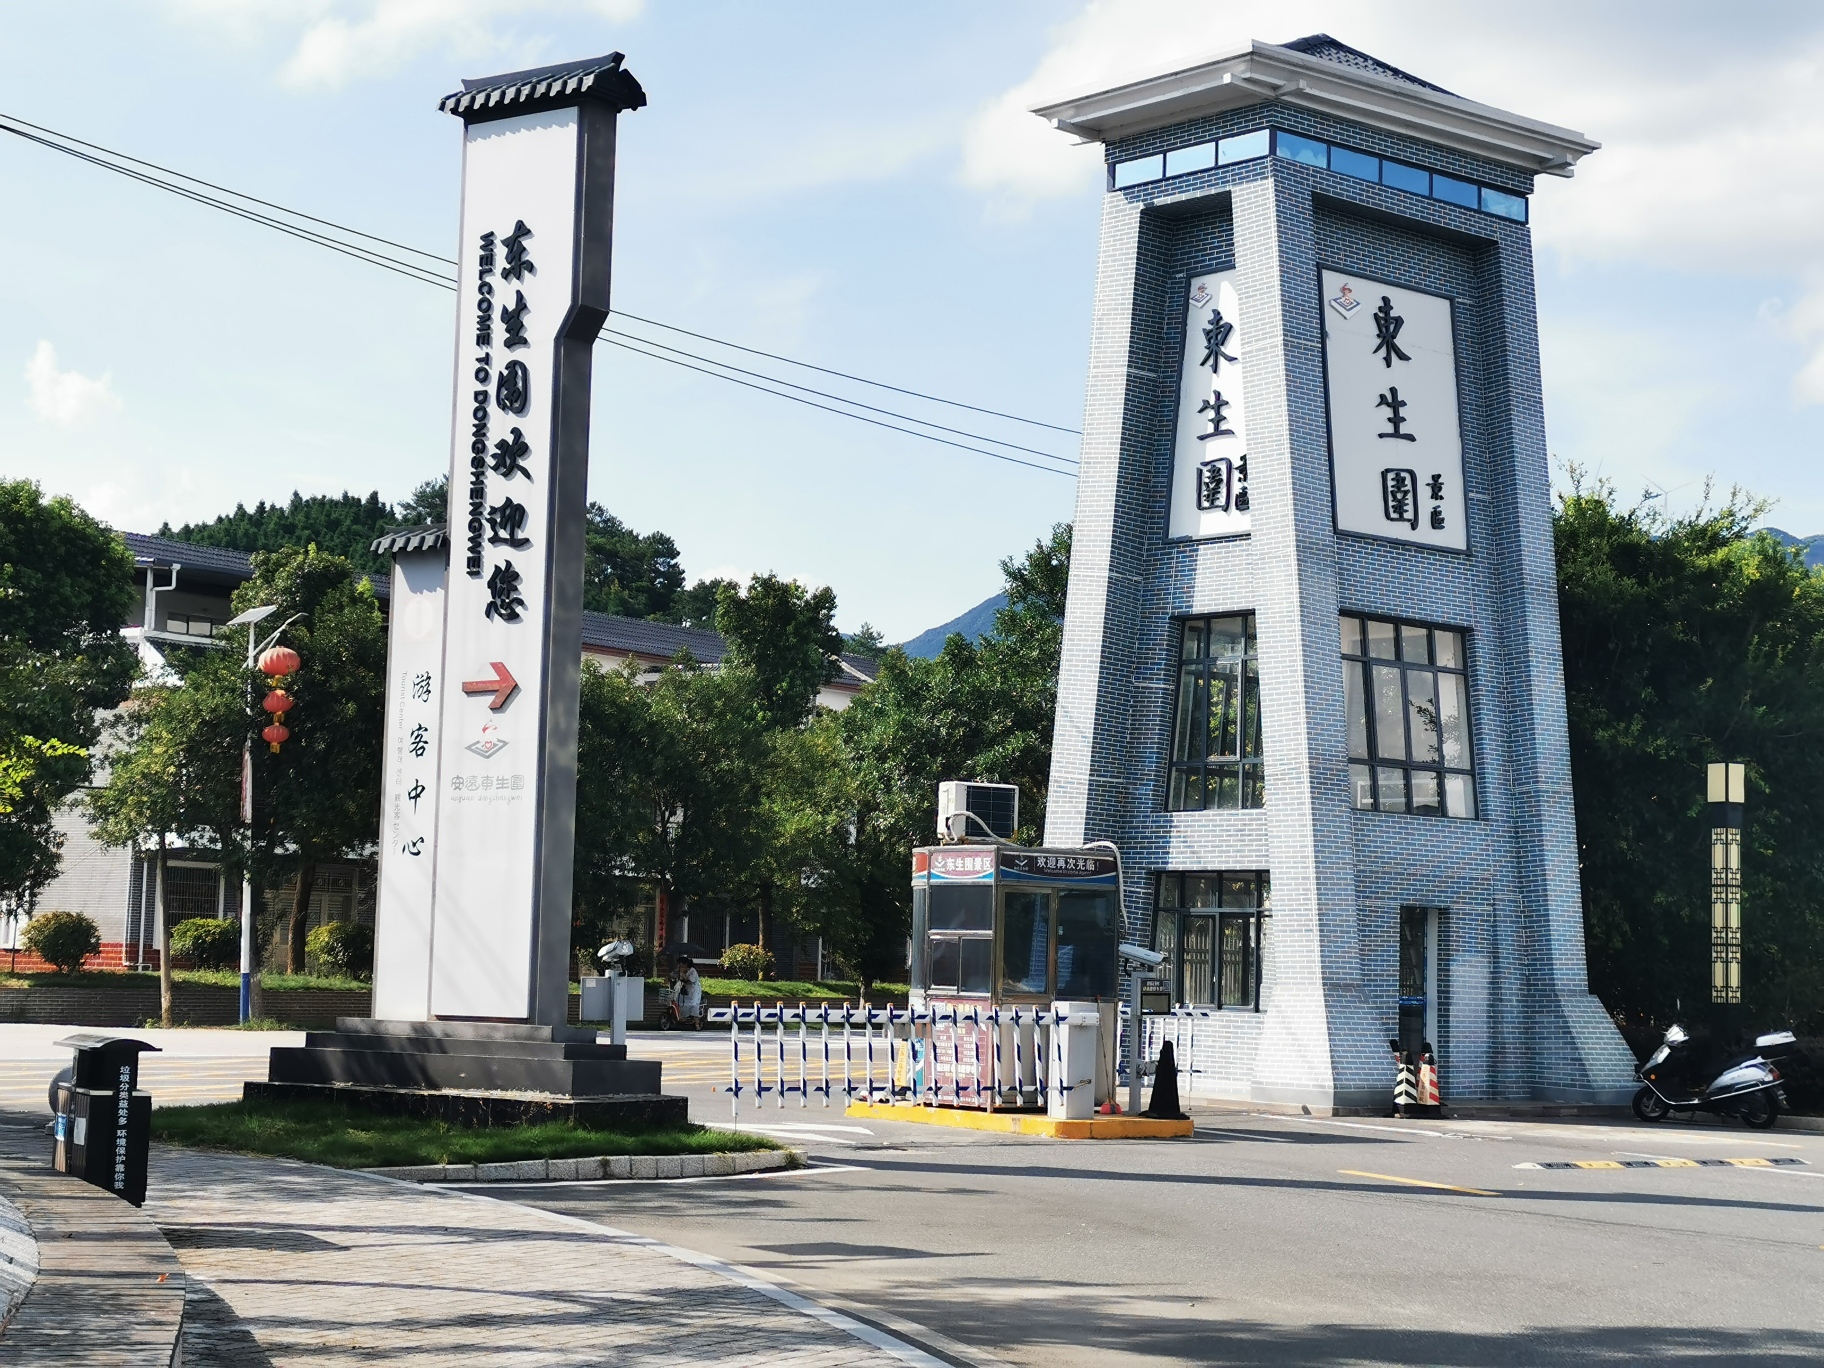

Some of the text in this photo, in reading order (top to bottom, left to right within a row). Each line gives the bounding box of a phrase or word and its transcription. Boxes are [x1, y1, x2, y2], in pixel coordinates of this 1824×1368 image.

[466, 231, 496, 579] WELCOME TO DONGSHENGWEI
[484, 219, 534, 623] 东生围欢迎您
[398, 670, 408, 730] Tourist Center
[402, 670, 432, 856] 游客中心
[946, 856, 992, 871] 东生围景区
[114, 1065, 131, 1189] 垃圾分类益处多 环境保护靠你我
